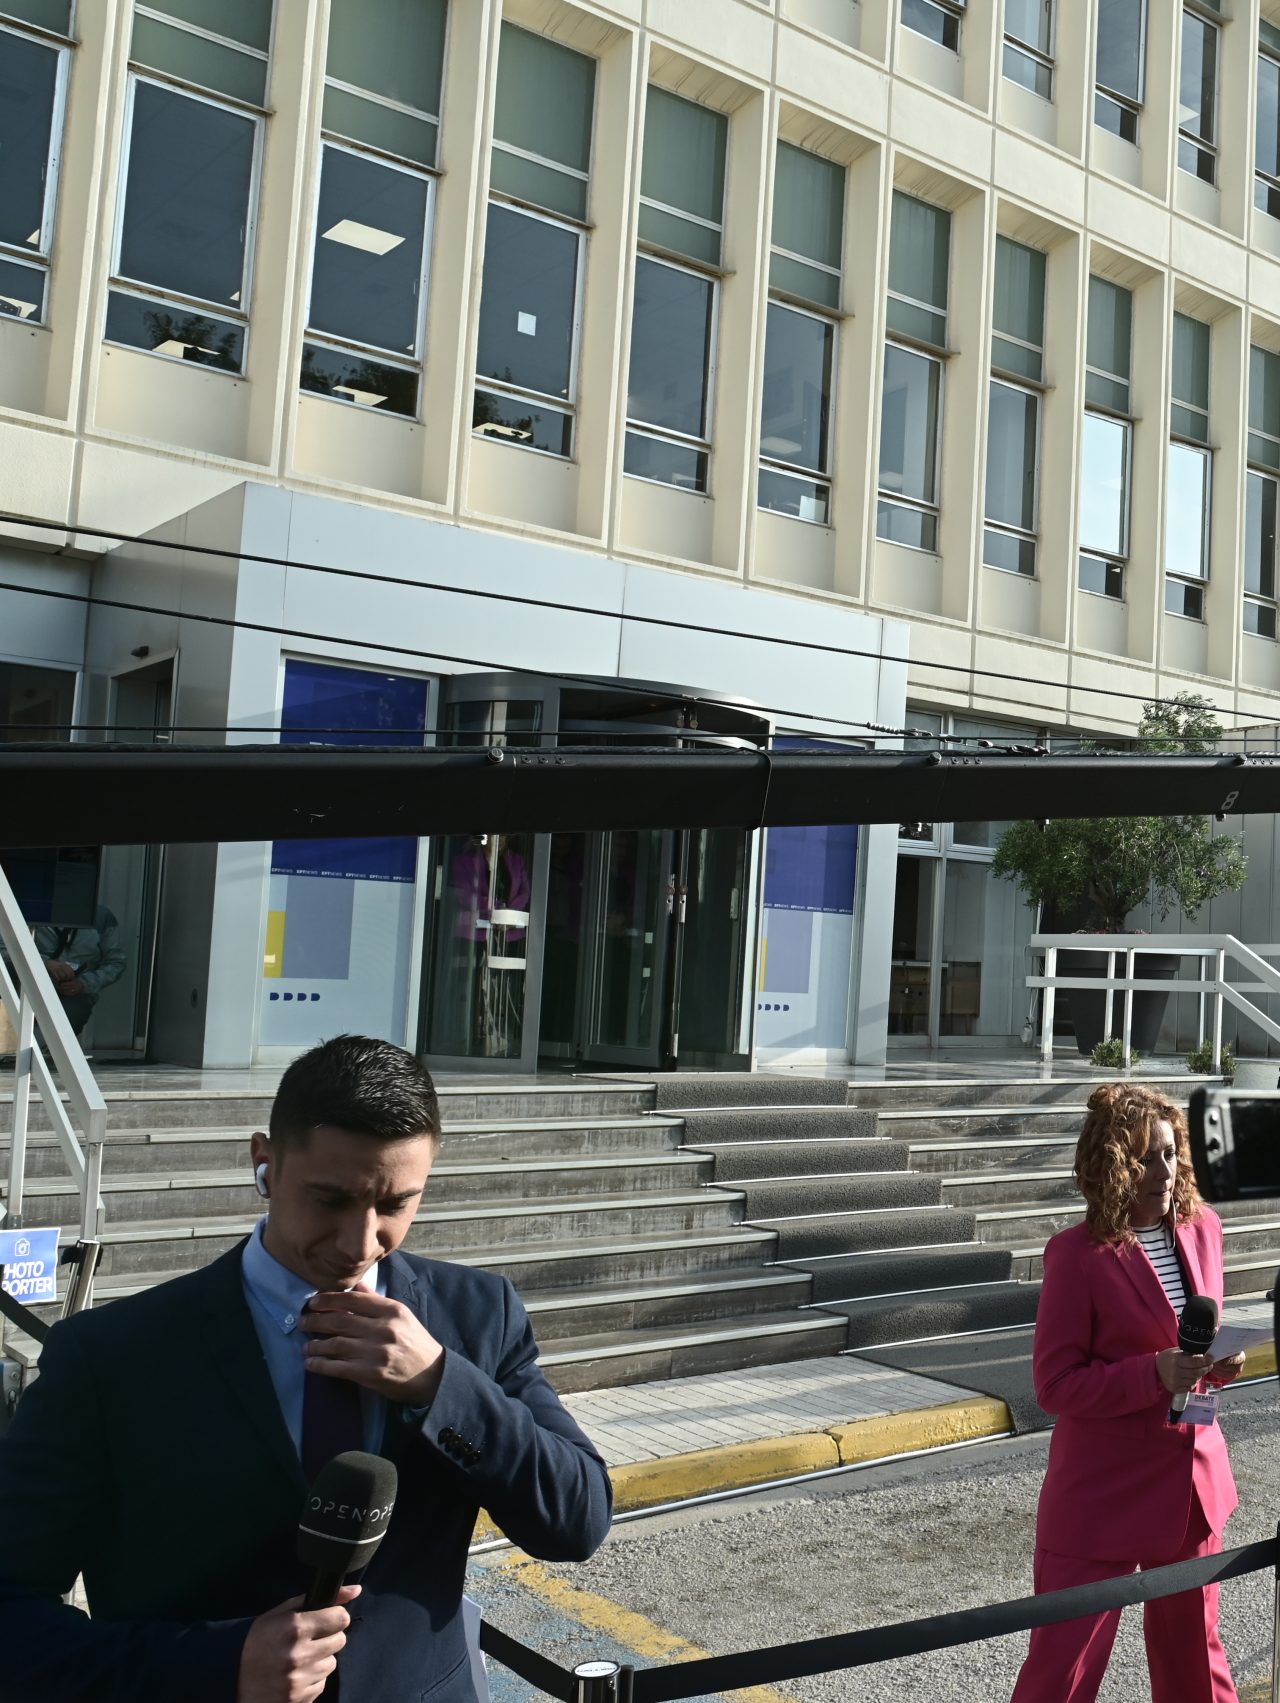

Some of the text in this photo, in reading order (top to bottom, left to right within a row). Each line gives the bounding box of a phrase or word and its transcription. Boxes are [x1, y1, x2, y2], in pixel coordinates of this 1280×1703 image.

[1221, 790, 1239, 811] 8
[1, 1276, 53, 1297] PORTER
[1194, 1394, 1215, 1402] DEBATE
[369, 1501, 395, 1523] OPE
